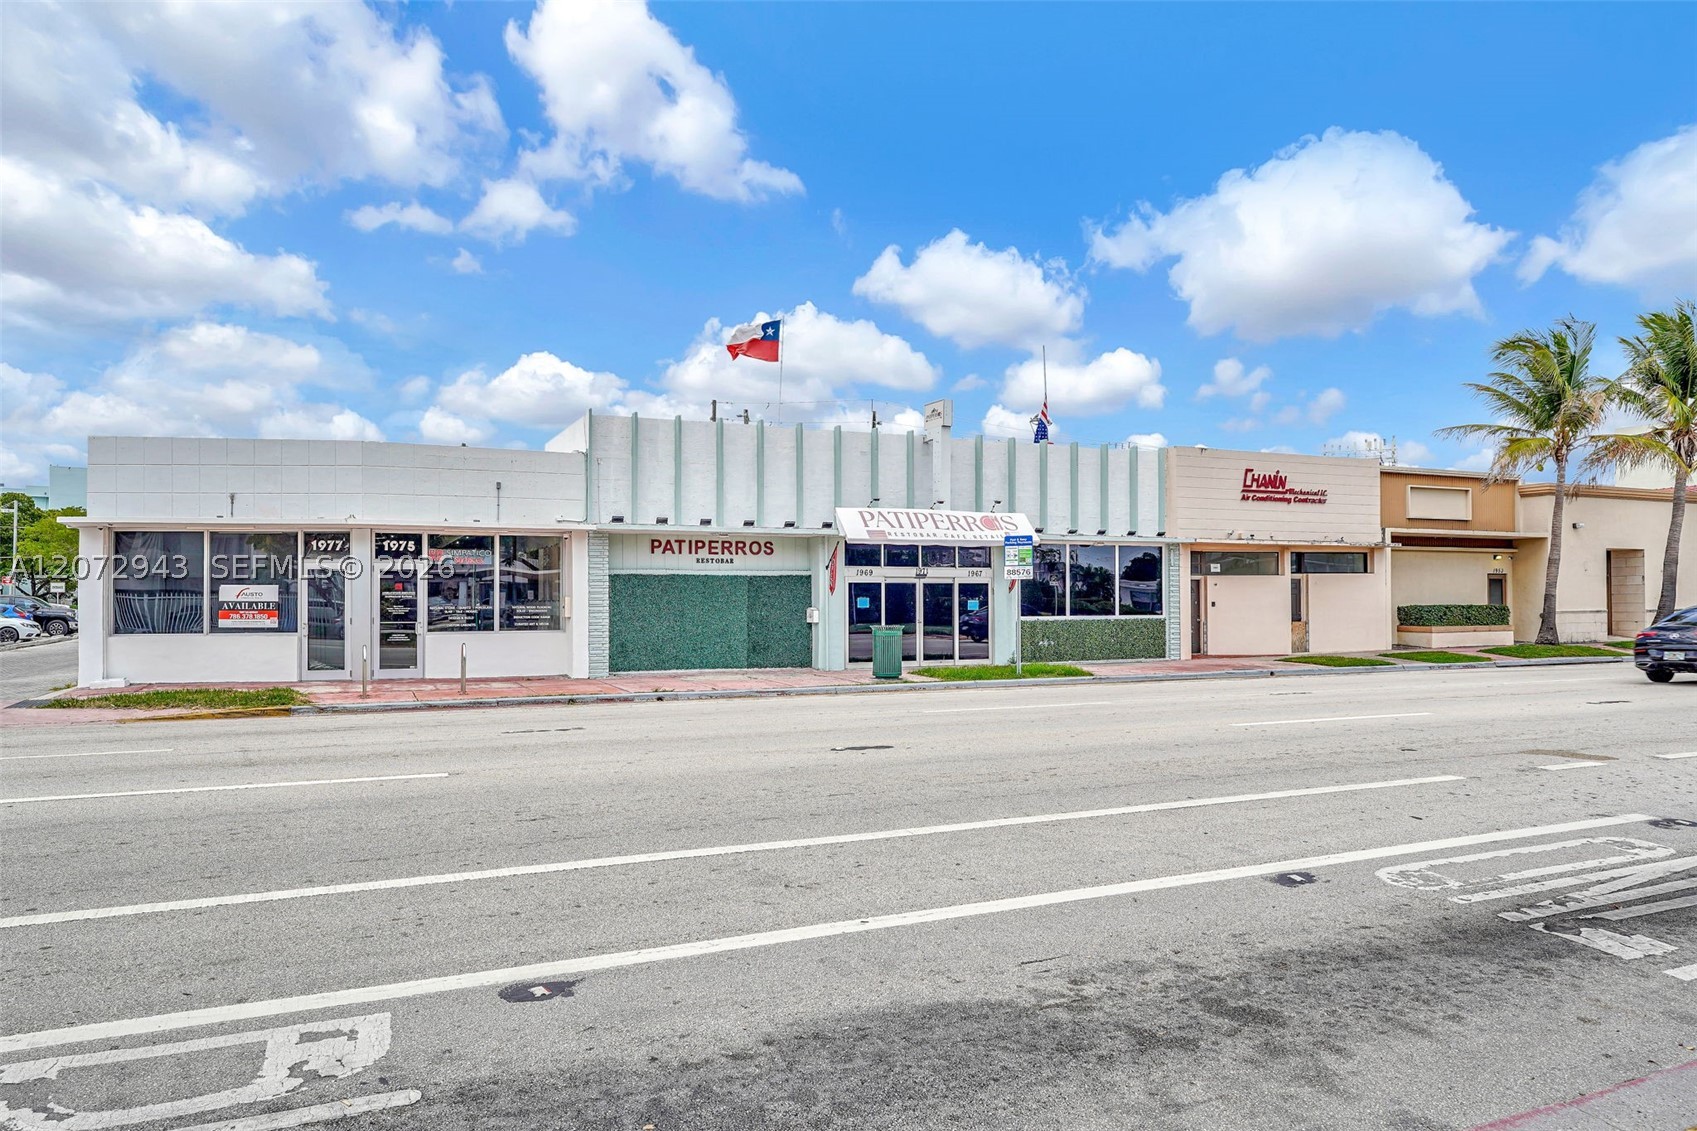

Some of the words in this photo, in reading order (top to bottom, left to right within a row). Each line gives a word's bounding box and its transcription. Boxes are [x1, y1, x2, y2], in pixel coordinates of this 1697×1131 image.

[1251, 494, 1292, 504] Conditioning
[1293, 496, 1327, 504] Contractor
[311, 540, 343, 551] 1977
[382, 540, 416, 551] 1975
[650, 539, 774, 555] PATIPERROS
[222, 602, 276, 610] AVAILABLE
